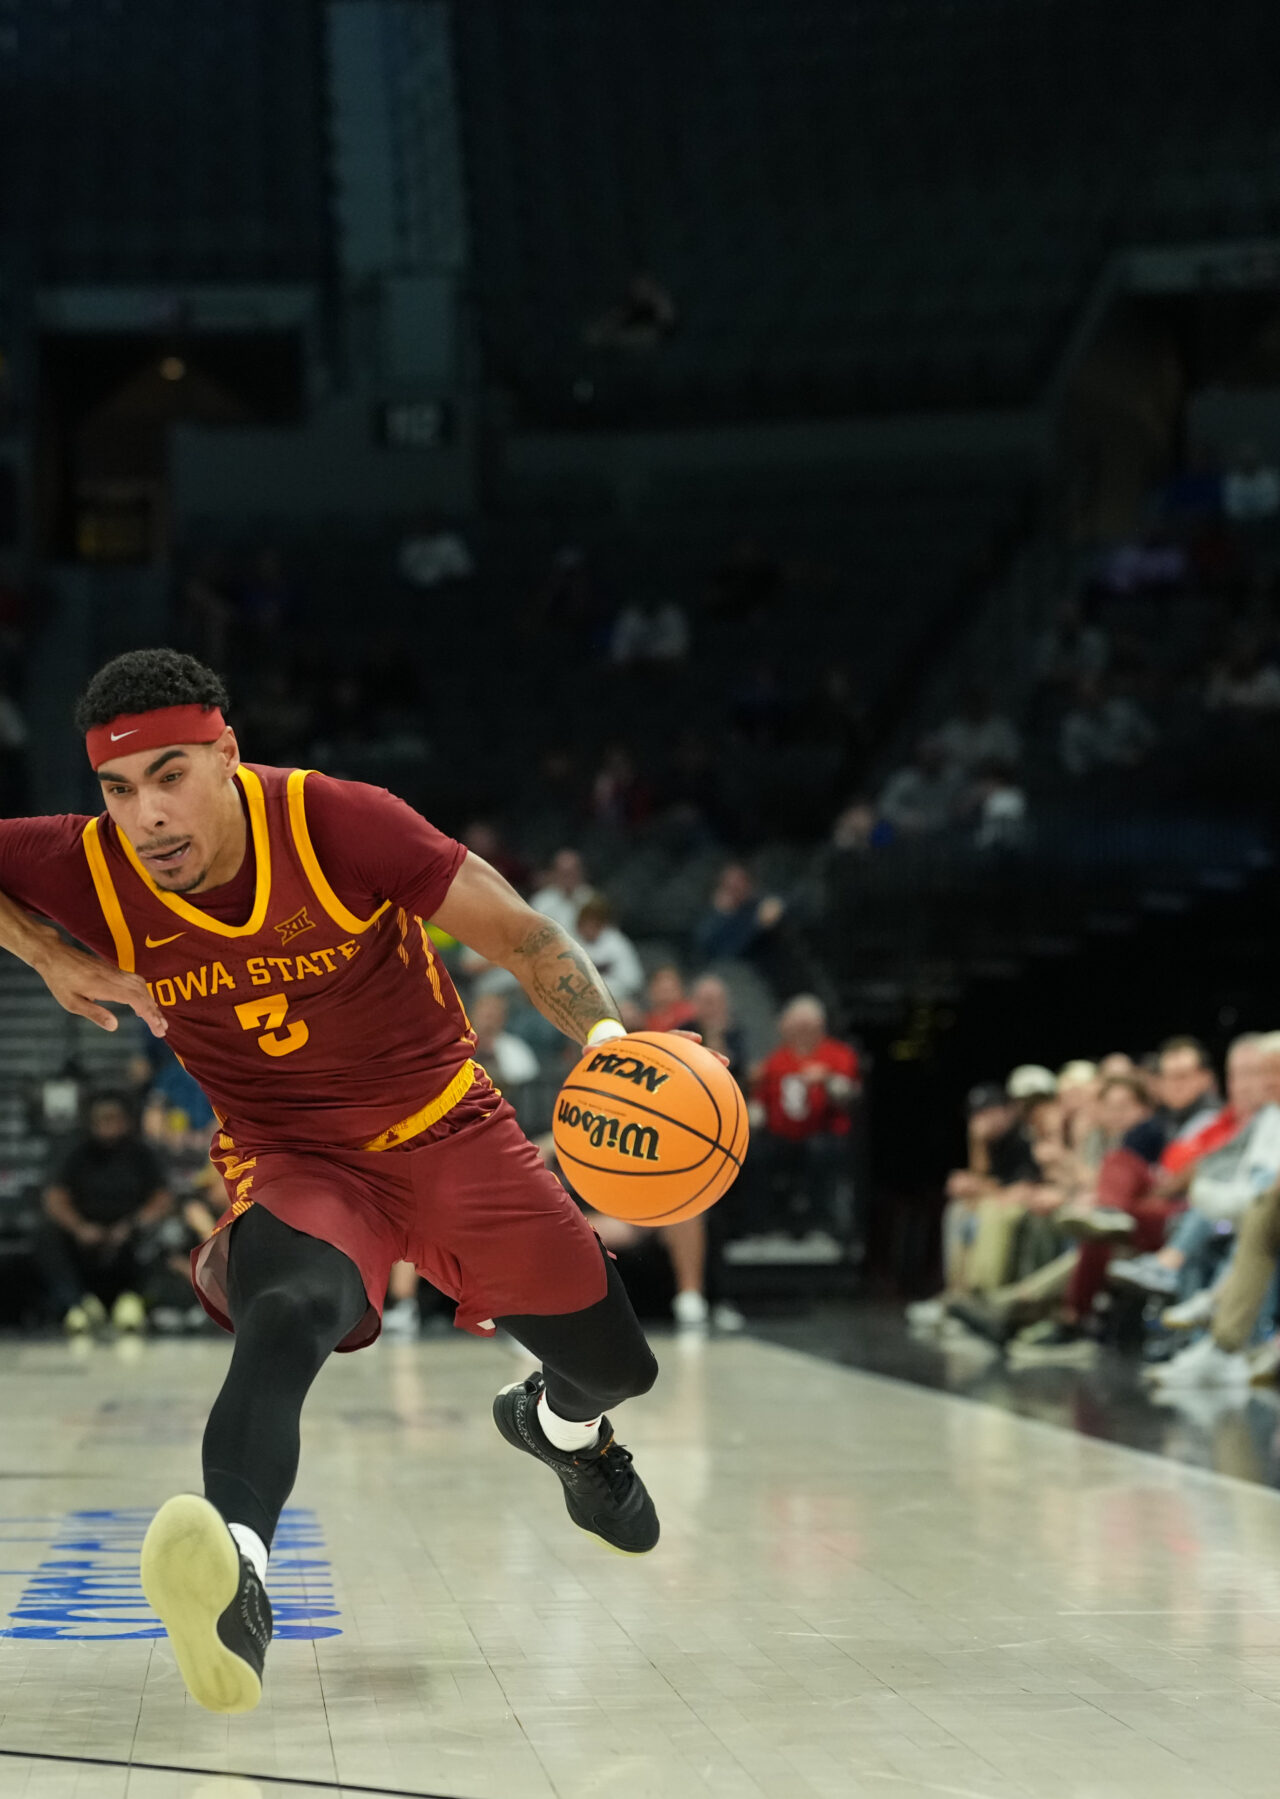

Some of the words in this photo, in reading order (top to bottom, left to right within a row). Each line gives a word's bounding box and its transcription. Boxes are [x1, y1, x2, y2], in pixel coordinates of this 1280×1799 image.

[246, 939, 361, 986] STATE
[234, 992, 310, 1057] 3
[586, 1052, 670, 1094] NCAA
[558, 1098, 660, 1162] Wilson
